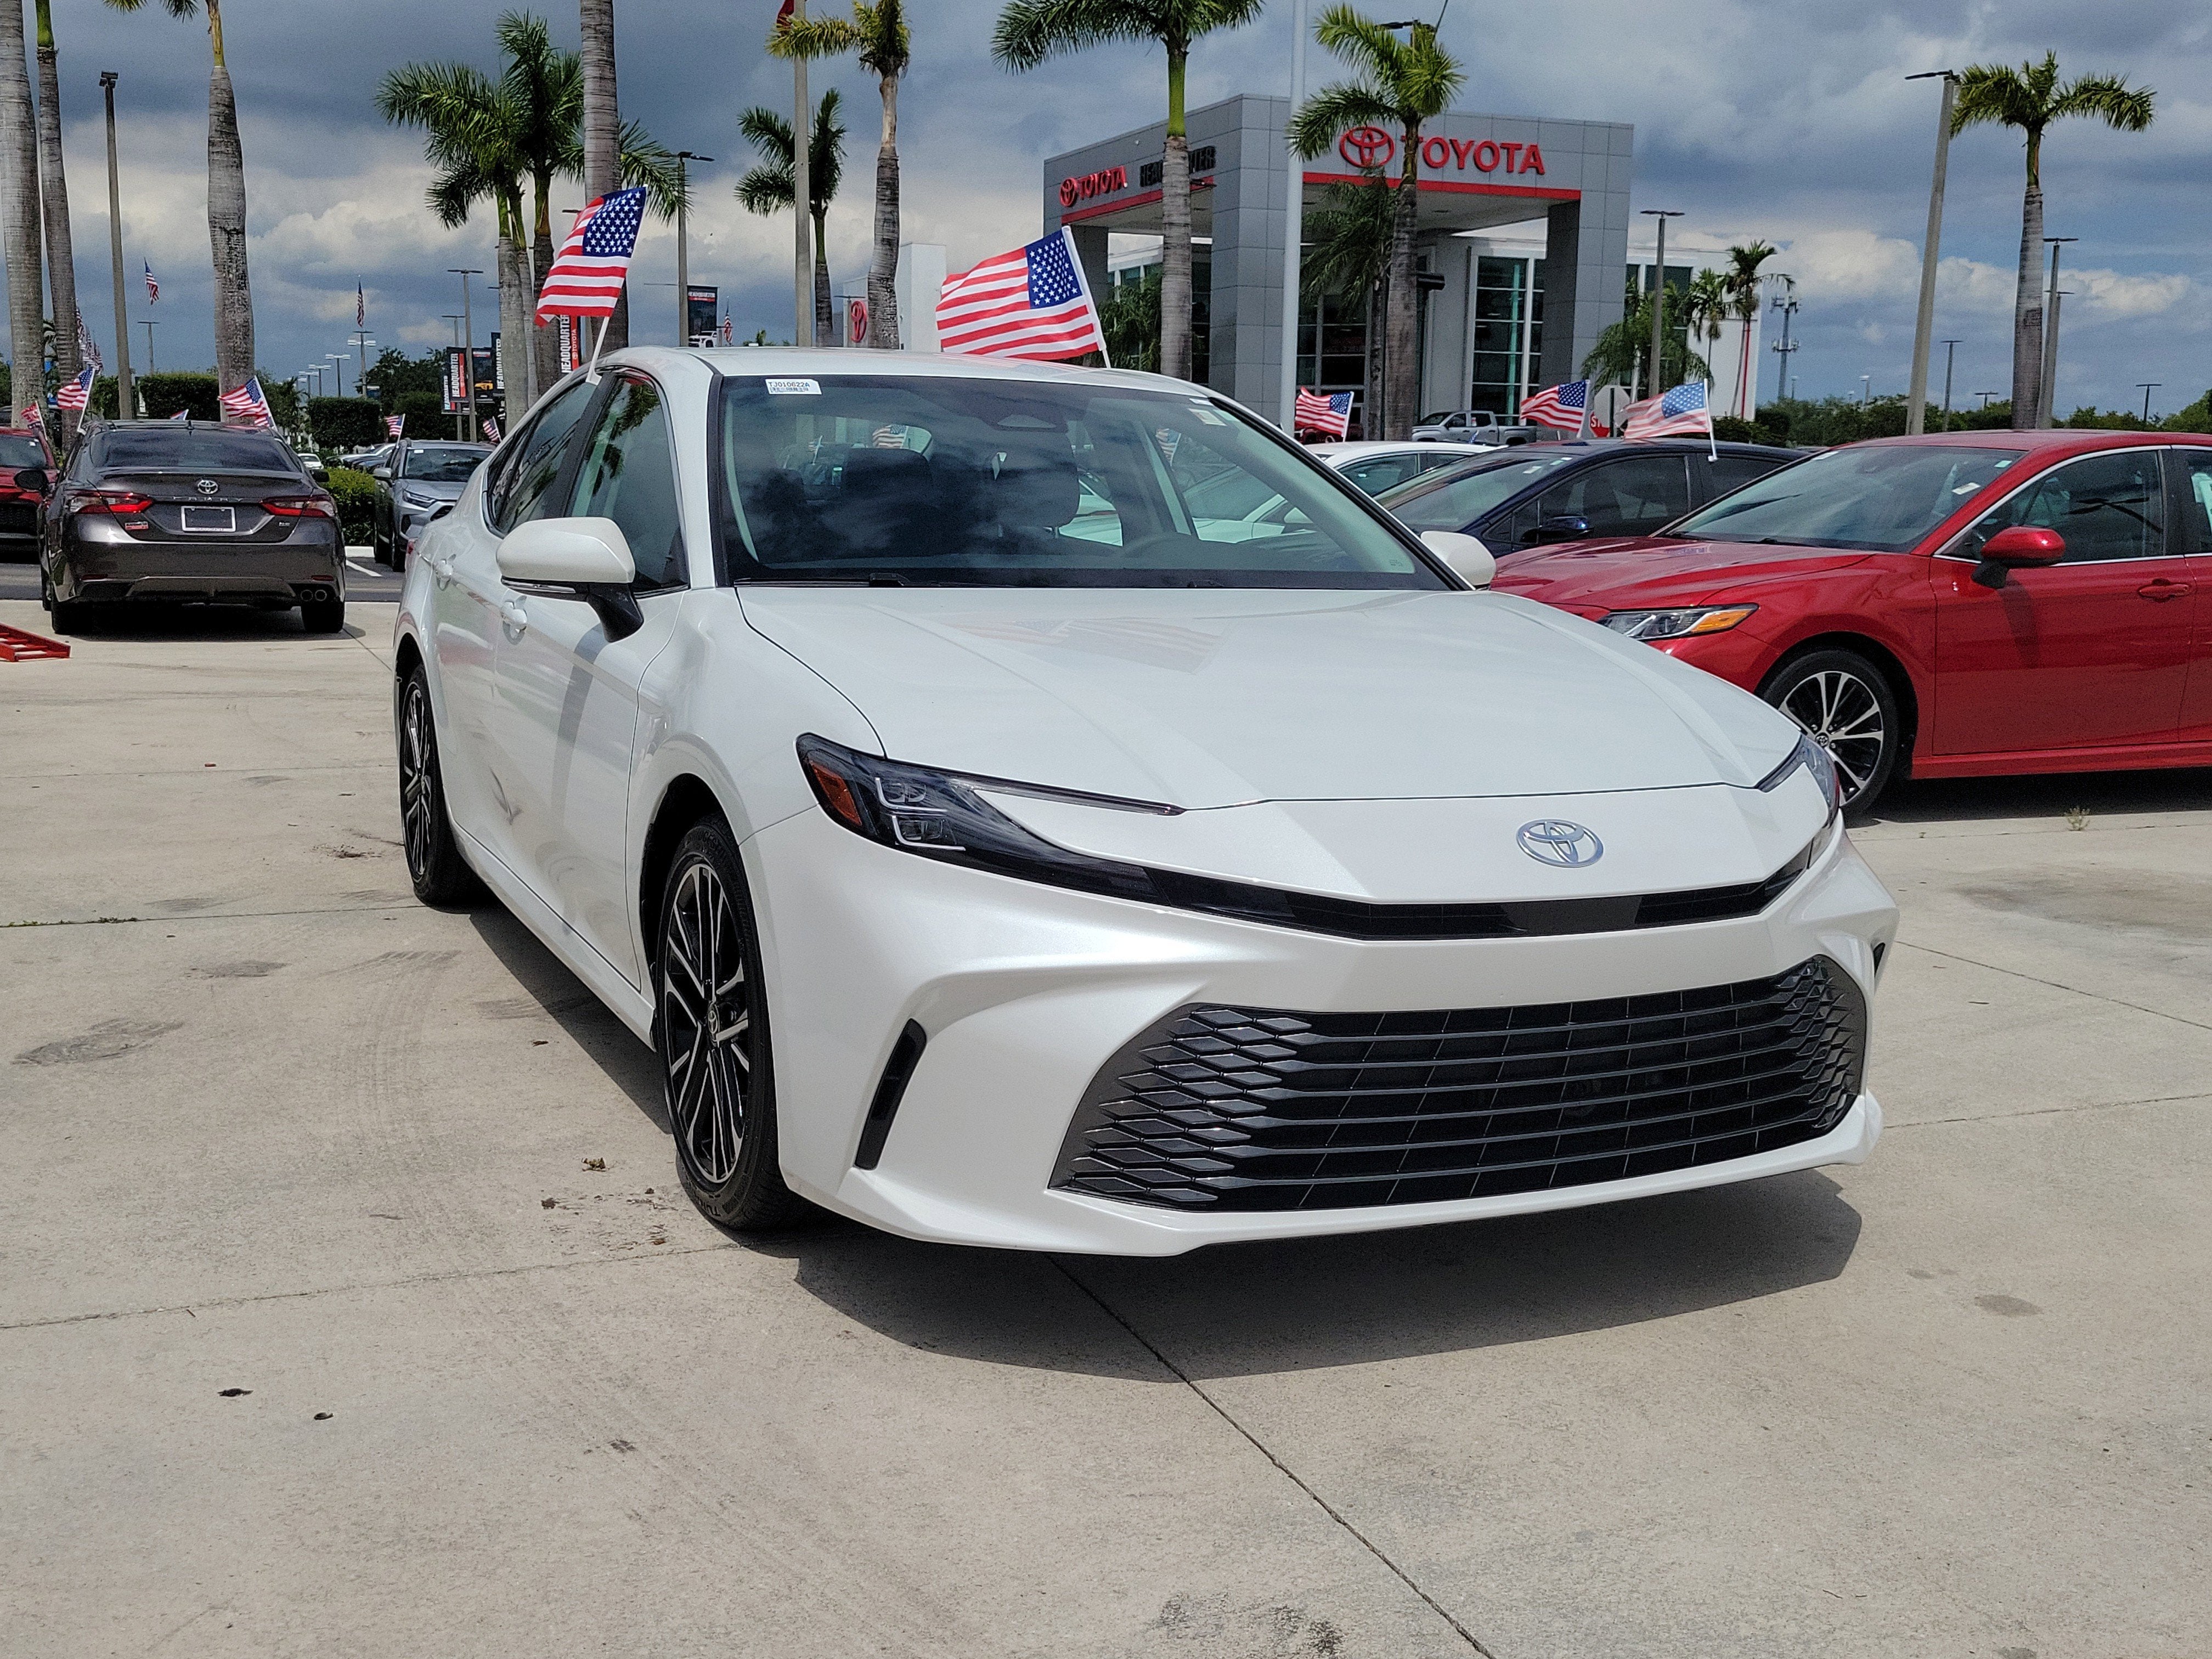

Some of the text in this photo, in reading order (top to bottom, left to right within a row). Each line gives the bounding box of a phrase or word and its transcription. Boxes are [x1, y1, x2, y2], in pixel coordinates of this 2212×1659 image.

[1401, 135, 1545, 175] OYOTA
[1076, 165, 1127, 200] TOYOTA
[450, 353, 460, 397] HEADQUARTER
